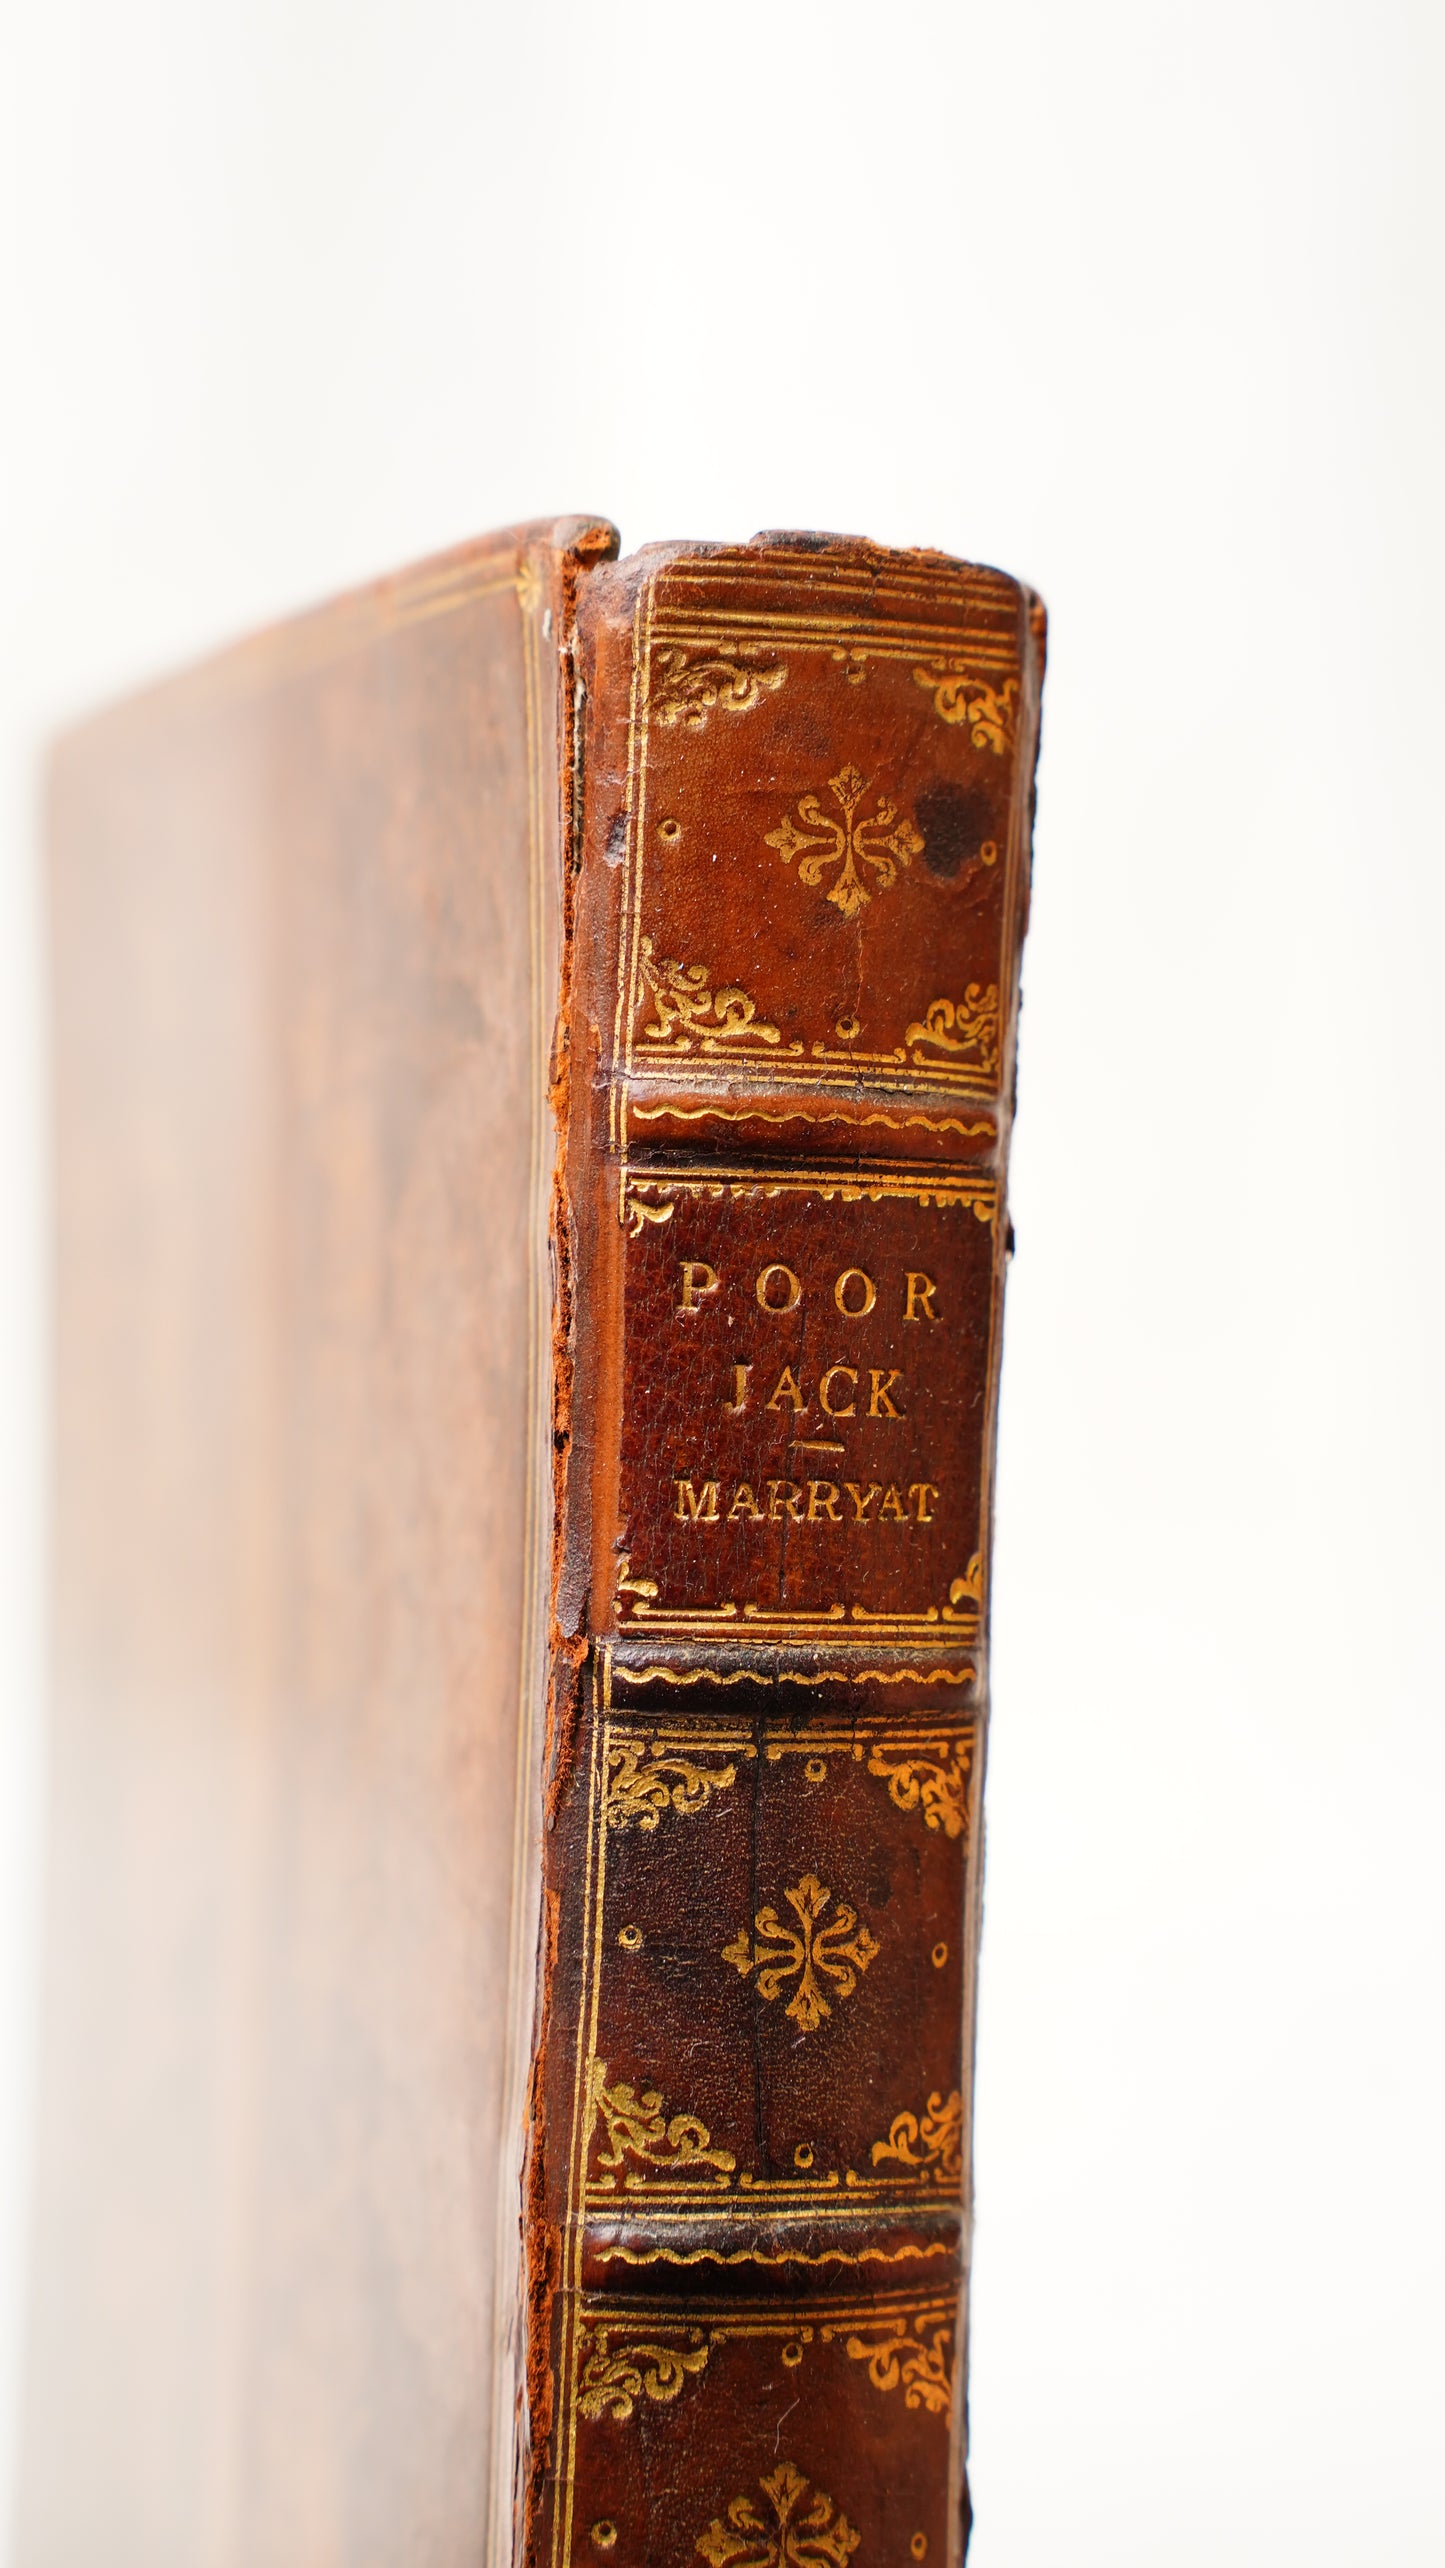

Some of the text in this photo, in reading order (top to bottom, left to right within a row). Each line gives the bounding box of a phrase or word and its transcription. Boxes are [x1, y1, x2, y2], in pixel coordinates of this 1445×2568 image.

[676, 1261, 942, 1321] POOR
[725, 1364, 906, 1418] JACK
[673, 1479, 940, 1523] MARRYAT
